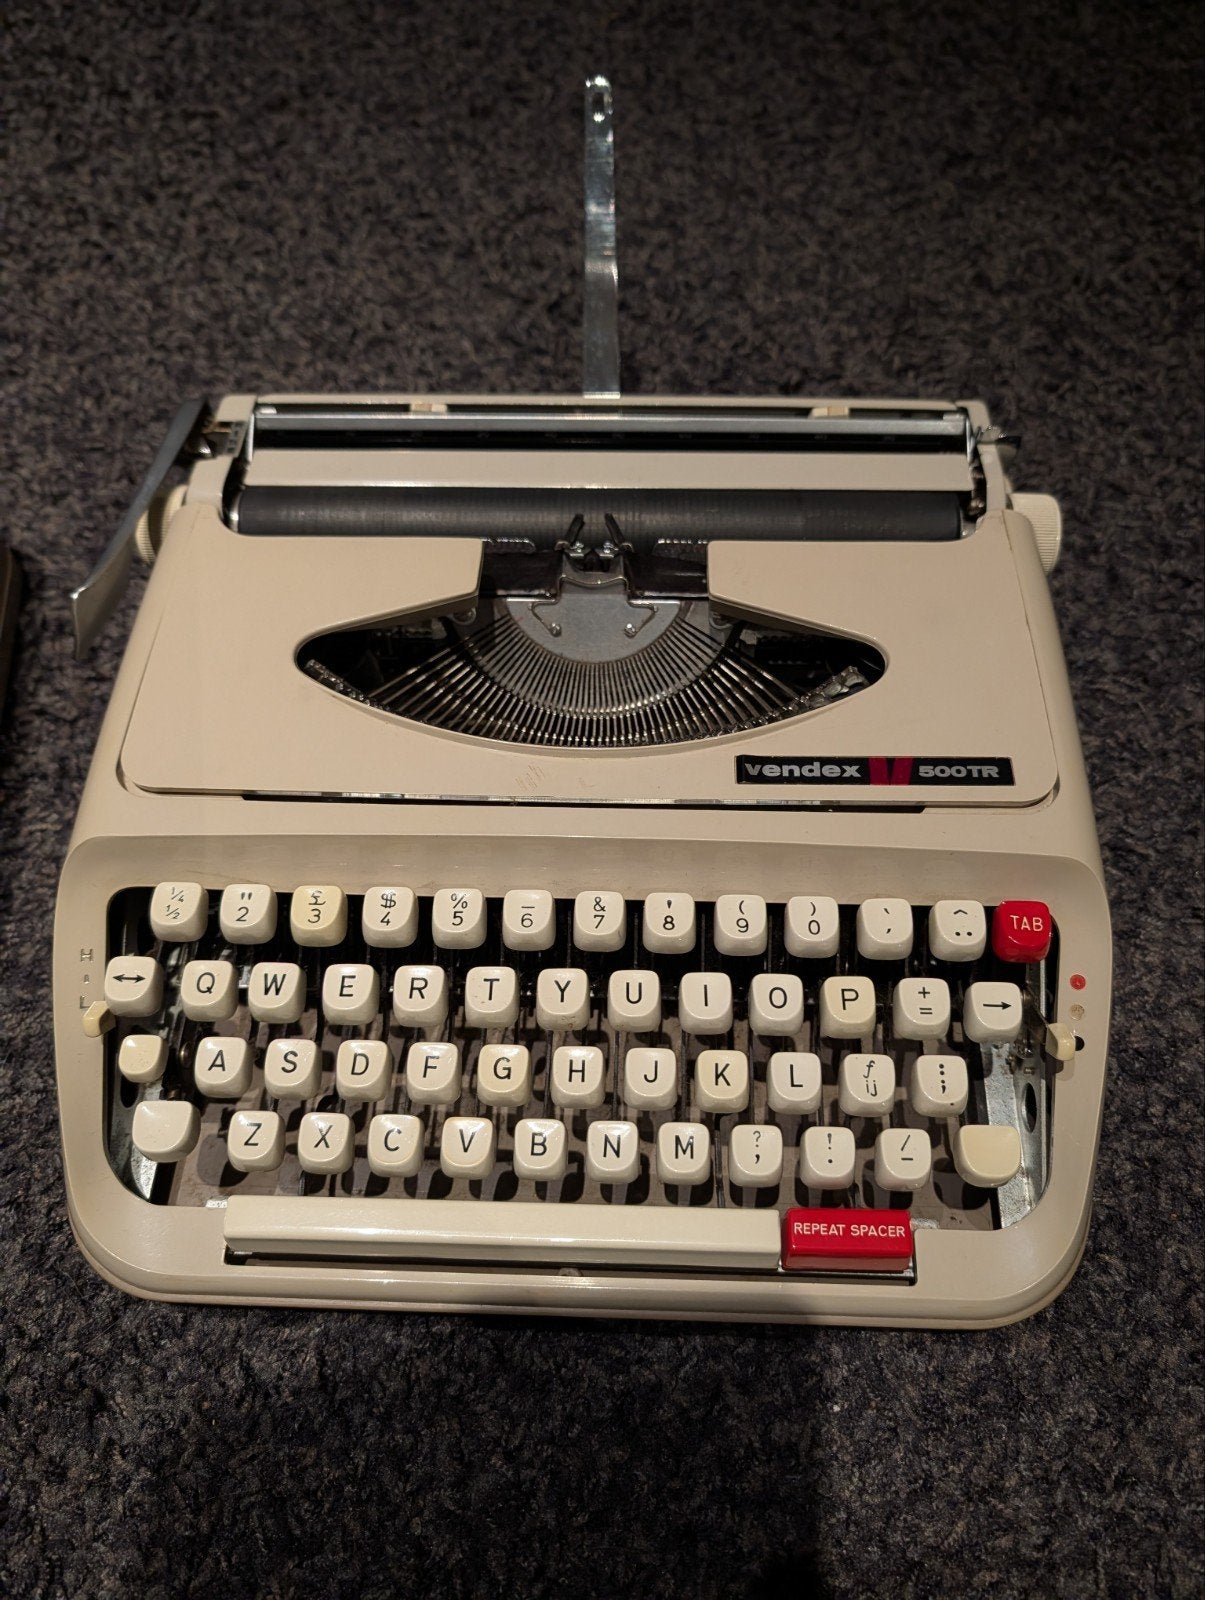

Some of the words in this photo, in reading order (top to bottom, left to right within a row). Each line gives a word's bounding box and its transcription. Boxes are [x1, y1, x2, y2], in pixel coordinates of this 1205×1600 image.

[744, 761, 861, 778] vendex
[918, 765, 1000, 778] 500TR
[309, 891, 326, 906] £
[381, 893, 396, 909] $
[450, 893, 467, 909] %
[593, 896, 606, 912] &
[236, 906, 249, 922] 2
[308, 908, 321, 923] 3
[380, 911, 391, 926] 4
[452, 911, 464, 926] 5
[521, 913, 533, 928] 6
[593, 915, 605, 929] 7
[663, 915, 675, 931] 8
[1009, 915, 1044, 932] TAB
[736, 918, 749, 933] 9
[196, 972, 215, 994] Q
[263, 973, 286, 996] W
[339, 975, 357, 997] E
[409, 977, 428, 999] R
[483, 978, 500, 1001] T
[554, 980, 571, 1003] Y
[625, 982, 642, 1004] U
[704, 984, 708, 1007] I
[769, 987, 787, 1009] O
[841, 988, 859, 1010] P
[208, 1049, 226, 1072] A
[281, 1050, 298, 1073] S
[351, 1053, 369, 1076] D
[423, 1055, 440, 1078] F
[493, 1057, 512, 1080] G
[568, 1059, 586, 1083] H
[643, 1060, 658, 1083] J
[714, 1063, 731, 1086] K
[790, 1064, 804, 1088] L
[243, 1122, 262, 1146] Z
[314, 1124, 334, 1149] X
[384, 1128, 402, 1152] C
[459, 1128, 476, 1153] V
[530, 1132, 548, 1156] B
[753, 1130, 761, 1148] ?
[603, 1134, 621, 1158] N
[674, 1135, 694, 1159] M
[794, 1222, 845, 1236] REPEAT
[850, 1224, 905, 1237] SPACER
